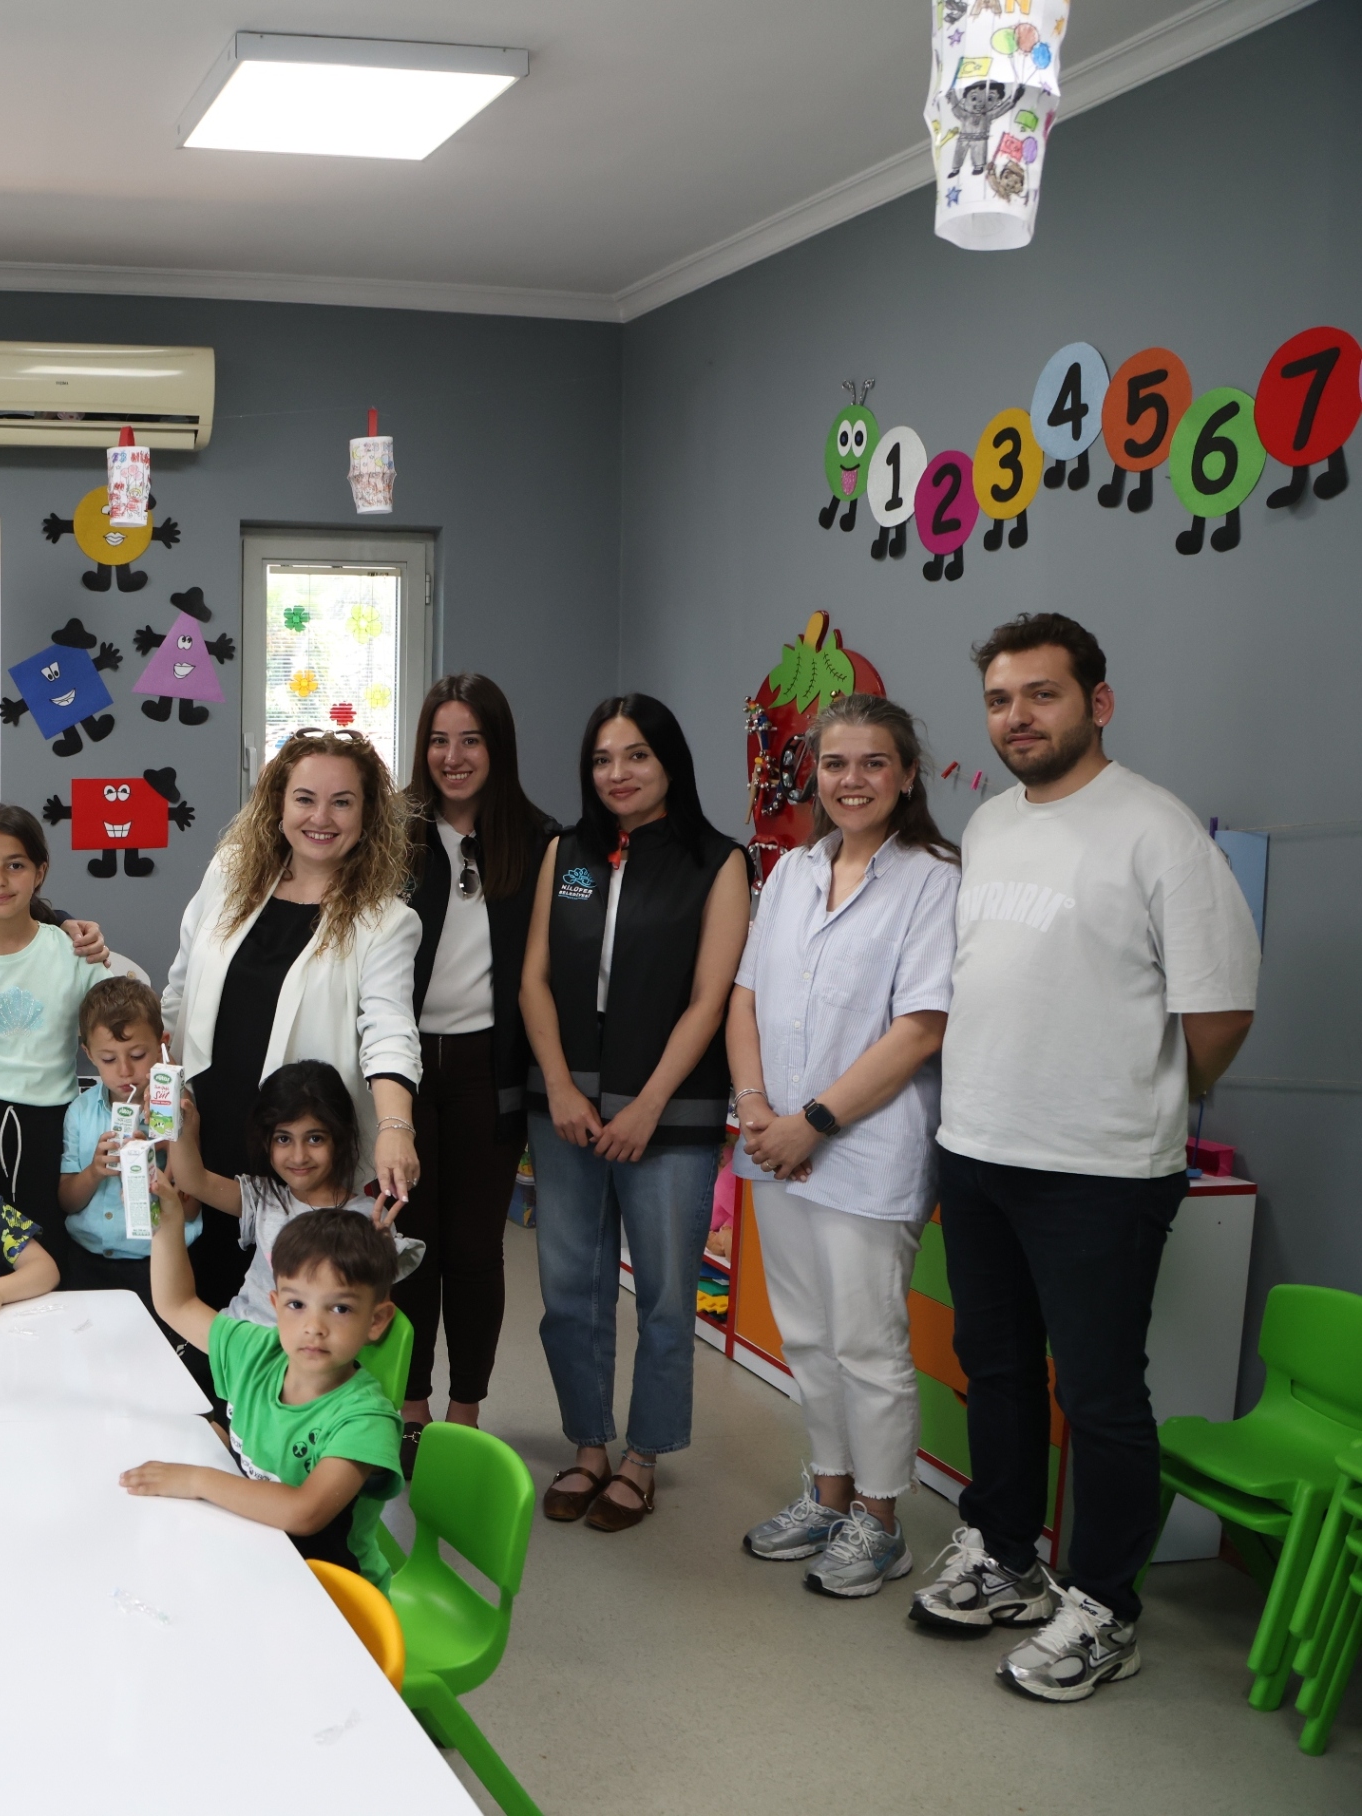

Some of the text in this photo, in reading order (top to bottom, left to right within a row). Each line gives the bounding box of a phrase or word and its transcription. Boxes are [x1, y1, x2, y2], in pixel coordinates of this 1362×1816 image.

[885, 346, 1341, 536] 1 2 3 4 5 6 7
